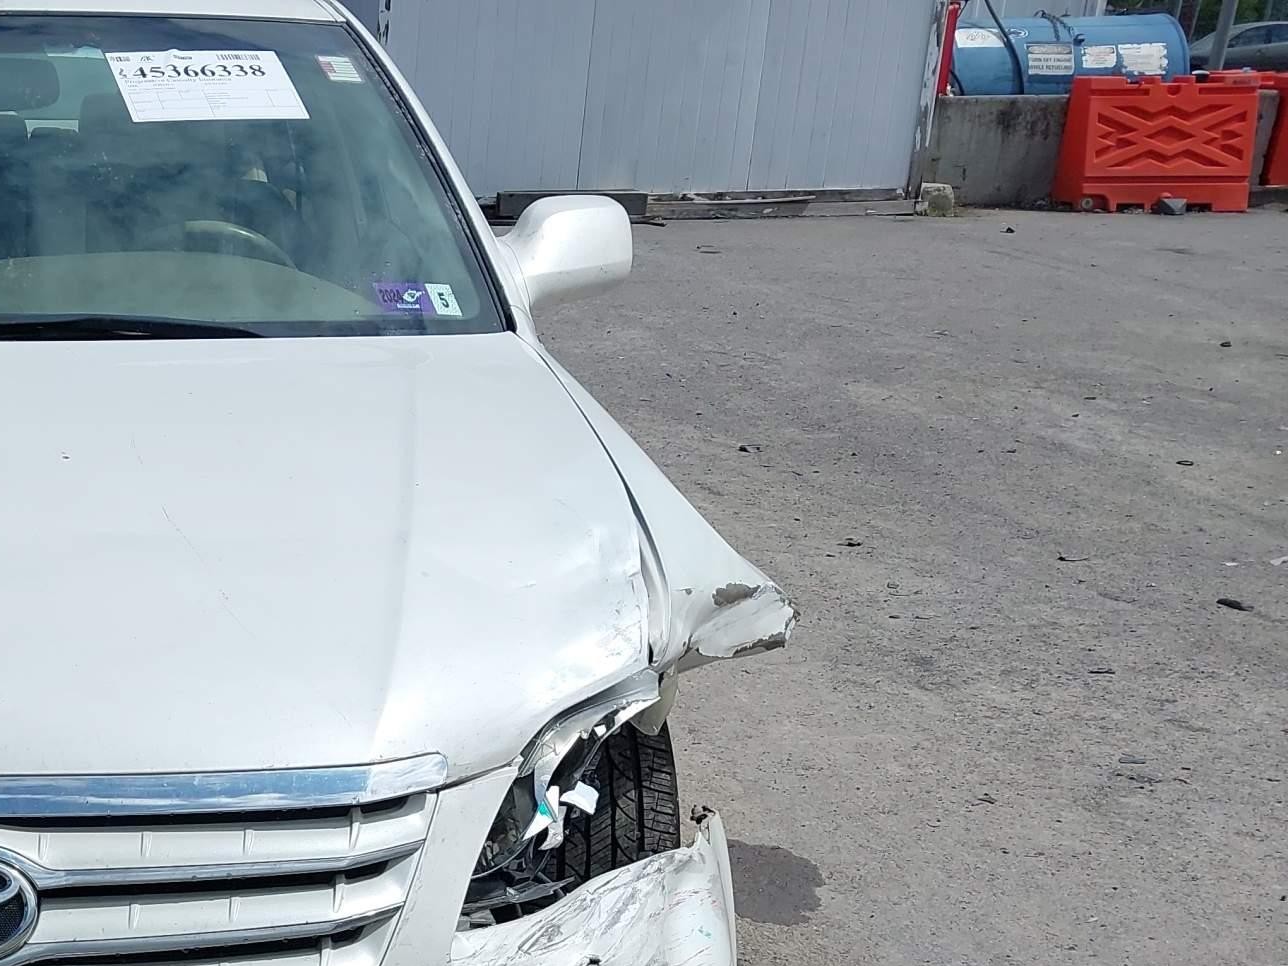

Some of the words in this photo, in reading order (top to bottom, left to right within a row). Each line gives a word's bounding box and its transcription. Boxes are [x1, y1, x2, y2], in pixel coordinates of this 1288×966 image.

[132, 63, 266, 79] 45366338
[379, 288, 404, 304] 2024
[437, 291, 450, 308] 5
